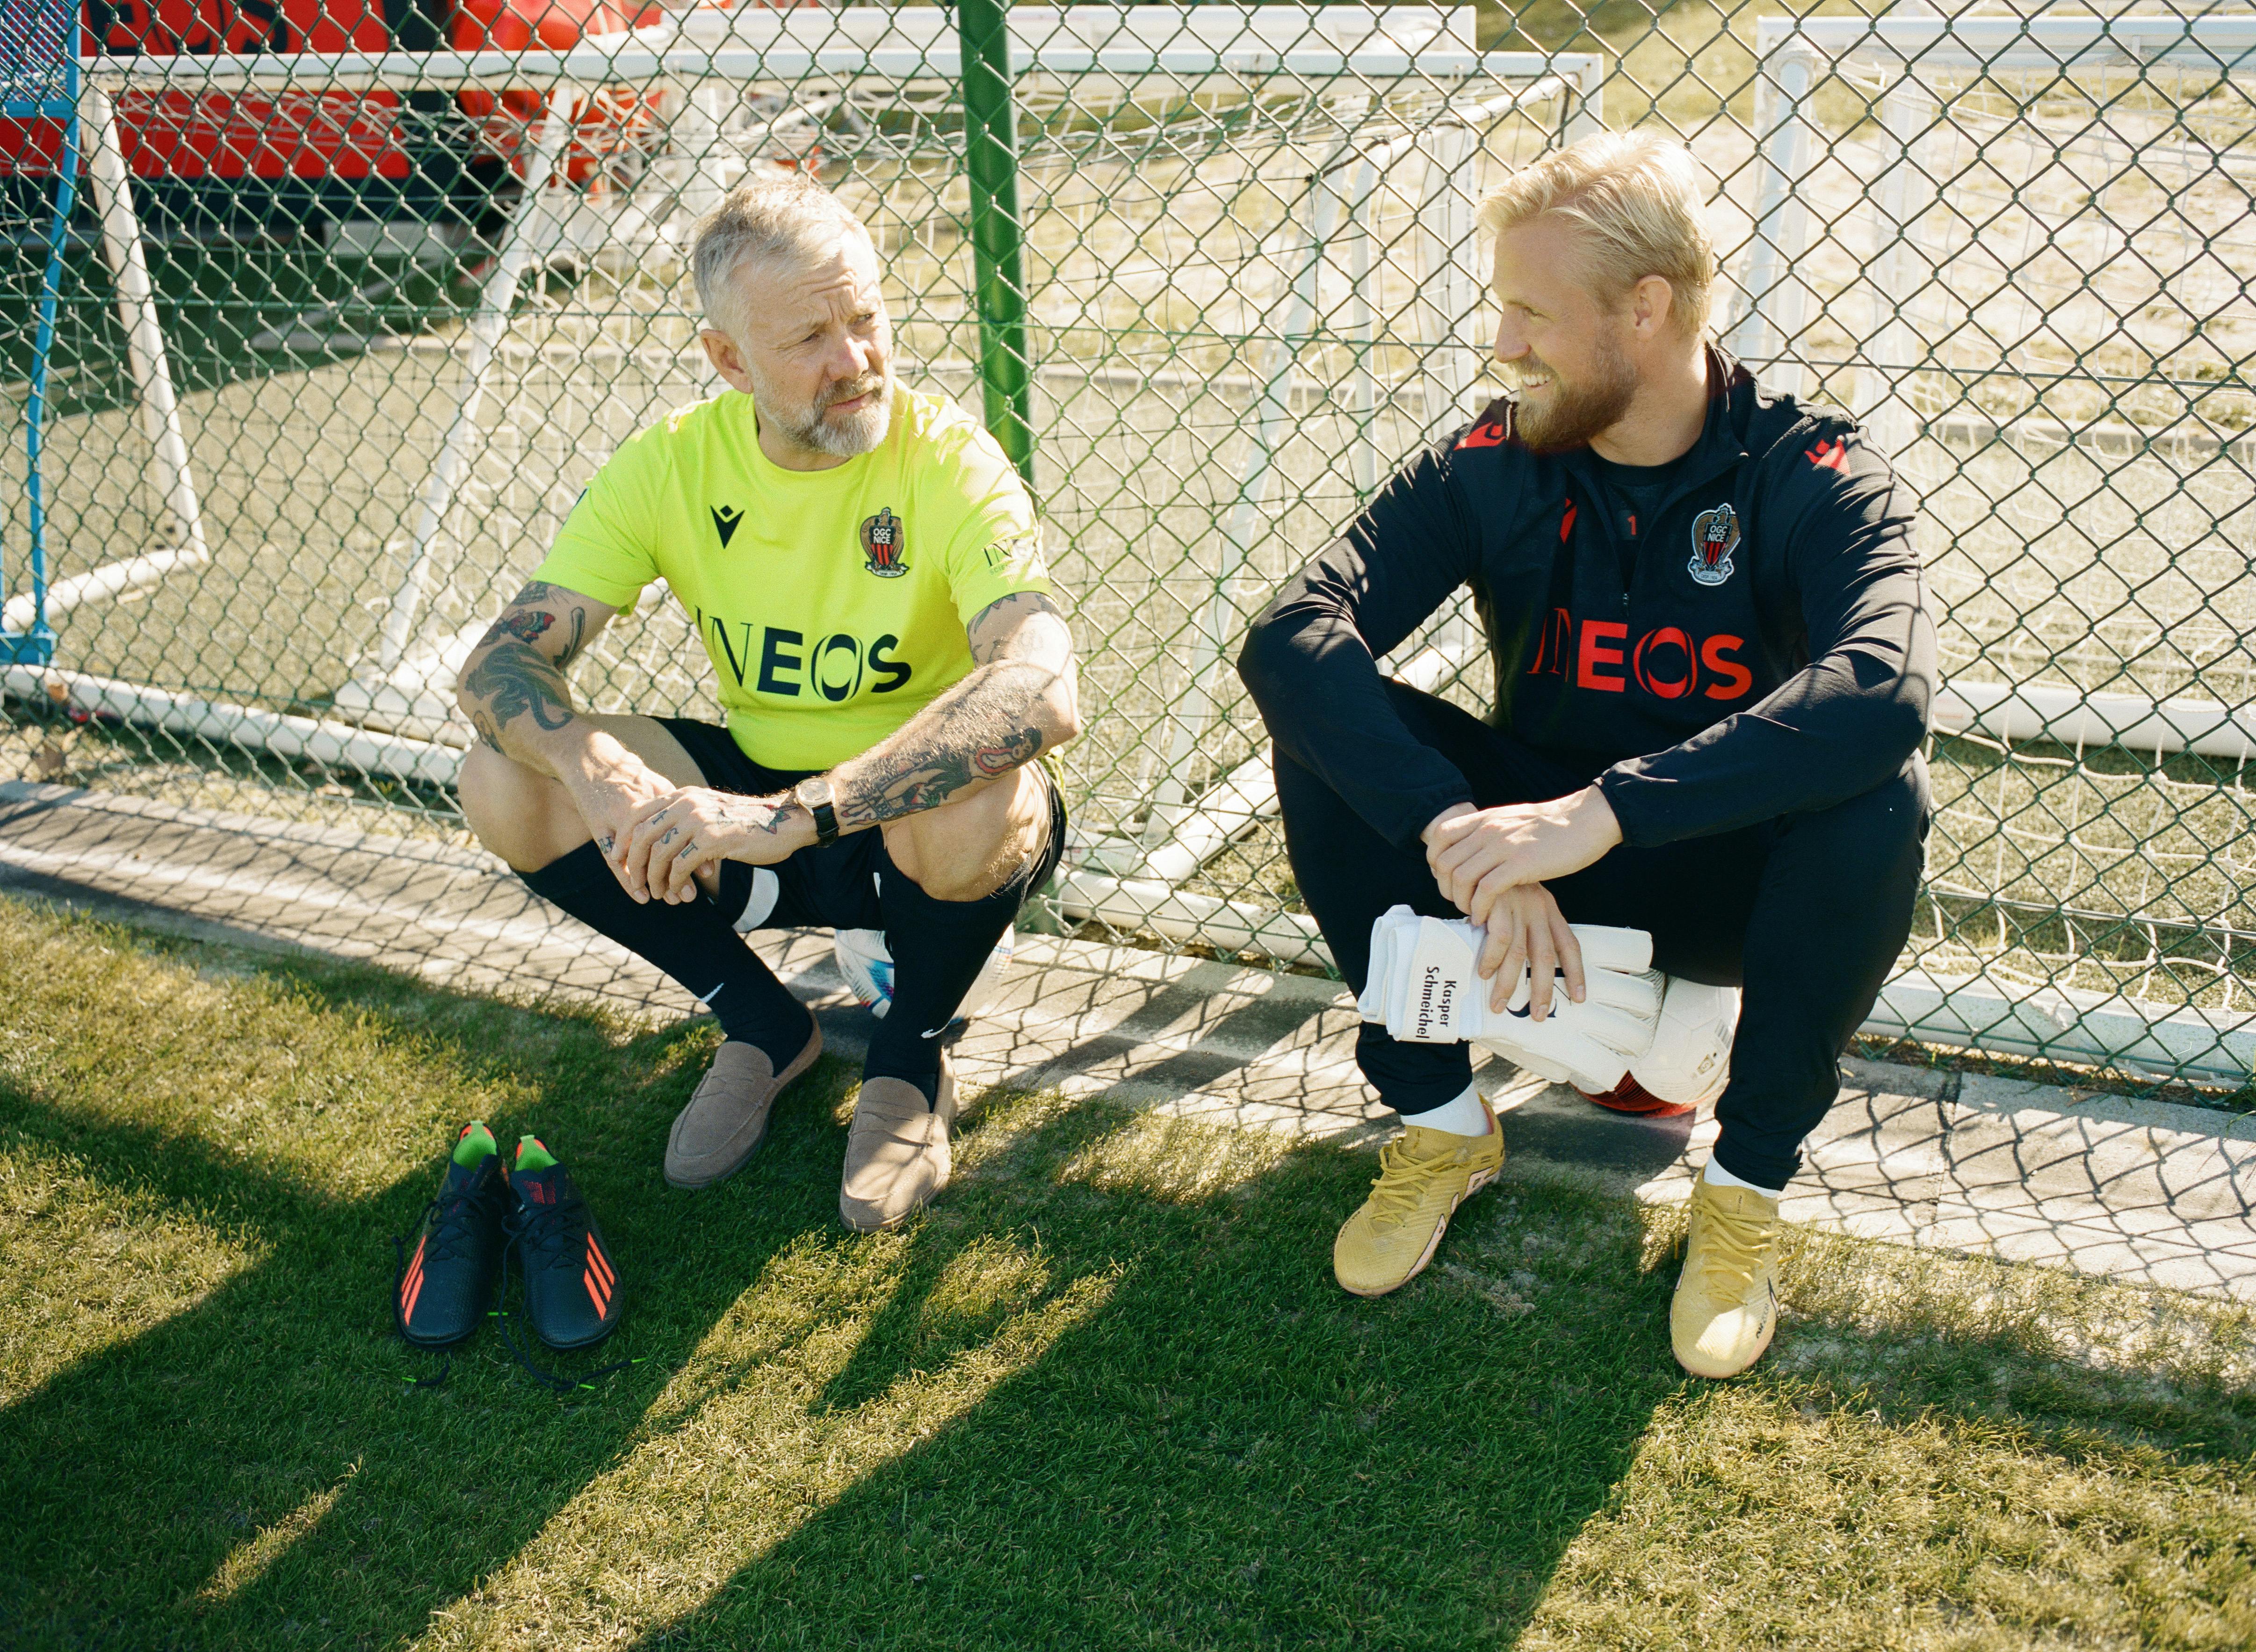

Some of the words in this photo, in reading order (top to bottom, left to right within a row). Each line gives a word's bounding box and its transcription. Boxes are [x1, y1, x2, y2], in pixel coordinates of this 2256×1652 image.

[1627, 515, 1636, 535] 1
[1710, 525, 1728, 534] OGC
[873, 528, 891, 536] OGC
[873, 536, 891, 544] NICE
[1707, 534, 1726, 542] NICE
[1416, 967, 1439, 1039] Schmeichel
[1438, 980, 1457, 1027] Kasper
